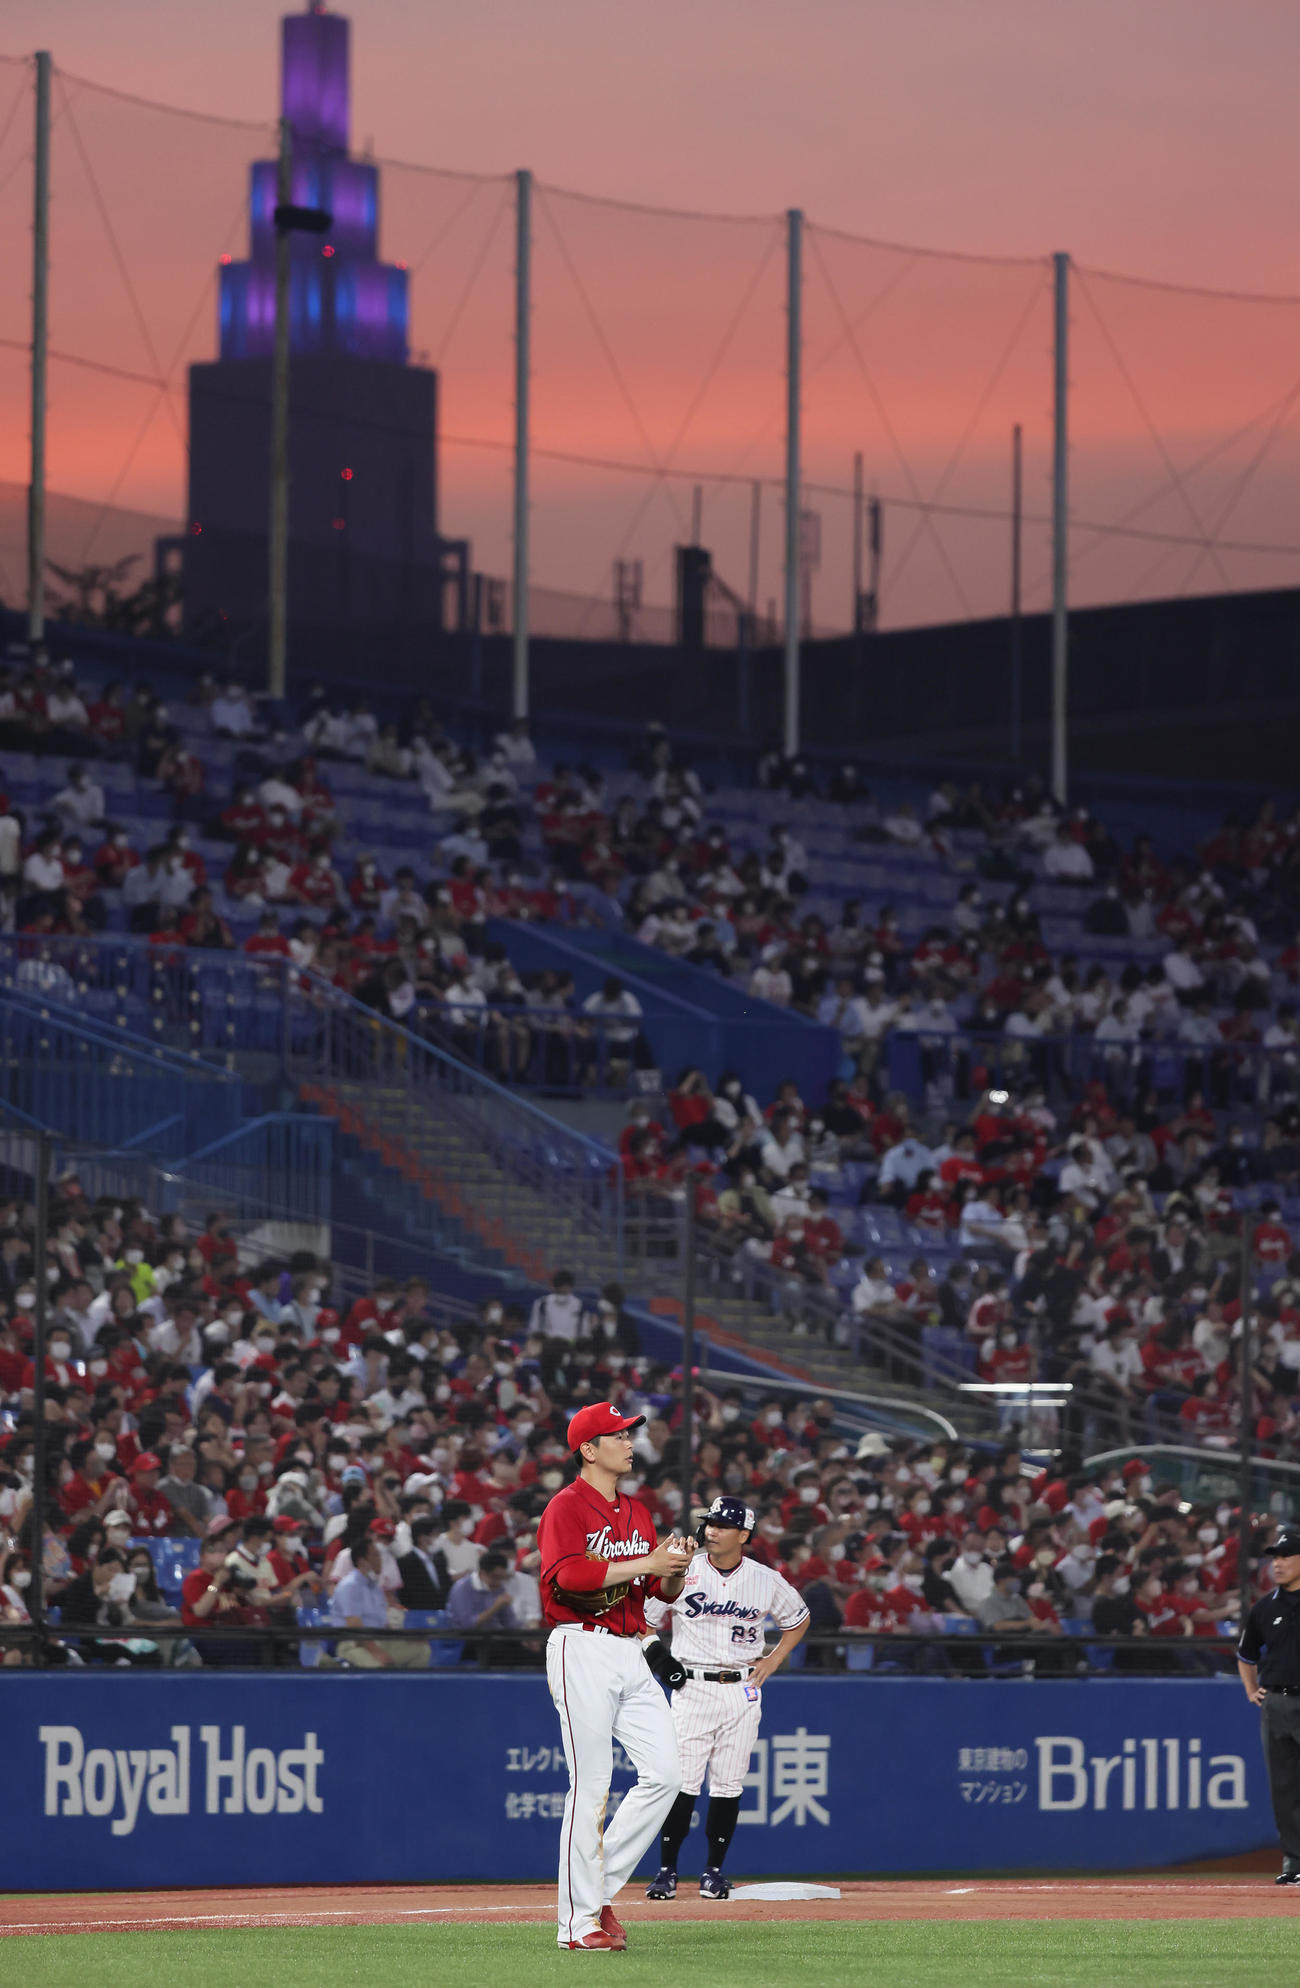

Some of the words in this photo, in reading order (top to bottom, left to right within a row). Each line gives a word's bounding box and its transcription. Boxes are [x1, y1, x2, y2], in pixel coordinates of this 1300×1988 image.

[586, 1525, 651, 1559] Hiroshim
[685, 1592, 760, 1620] Swallows
[732, 1625, 757, 1643] 23
[39, 1725, 190, 1836] Royal
[200, 1725, 324, 1814] Host
[1034, 1736, 1249, 1811] Brillia
